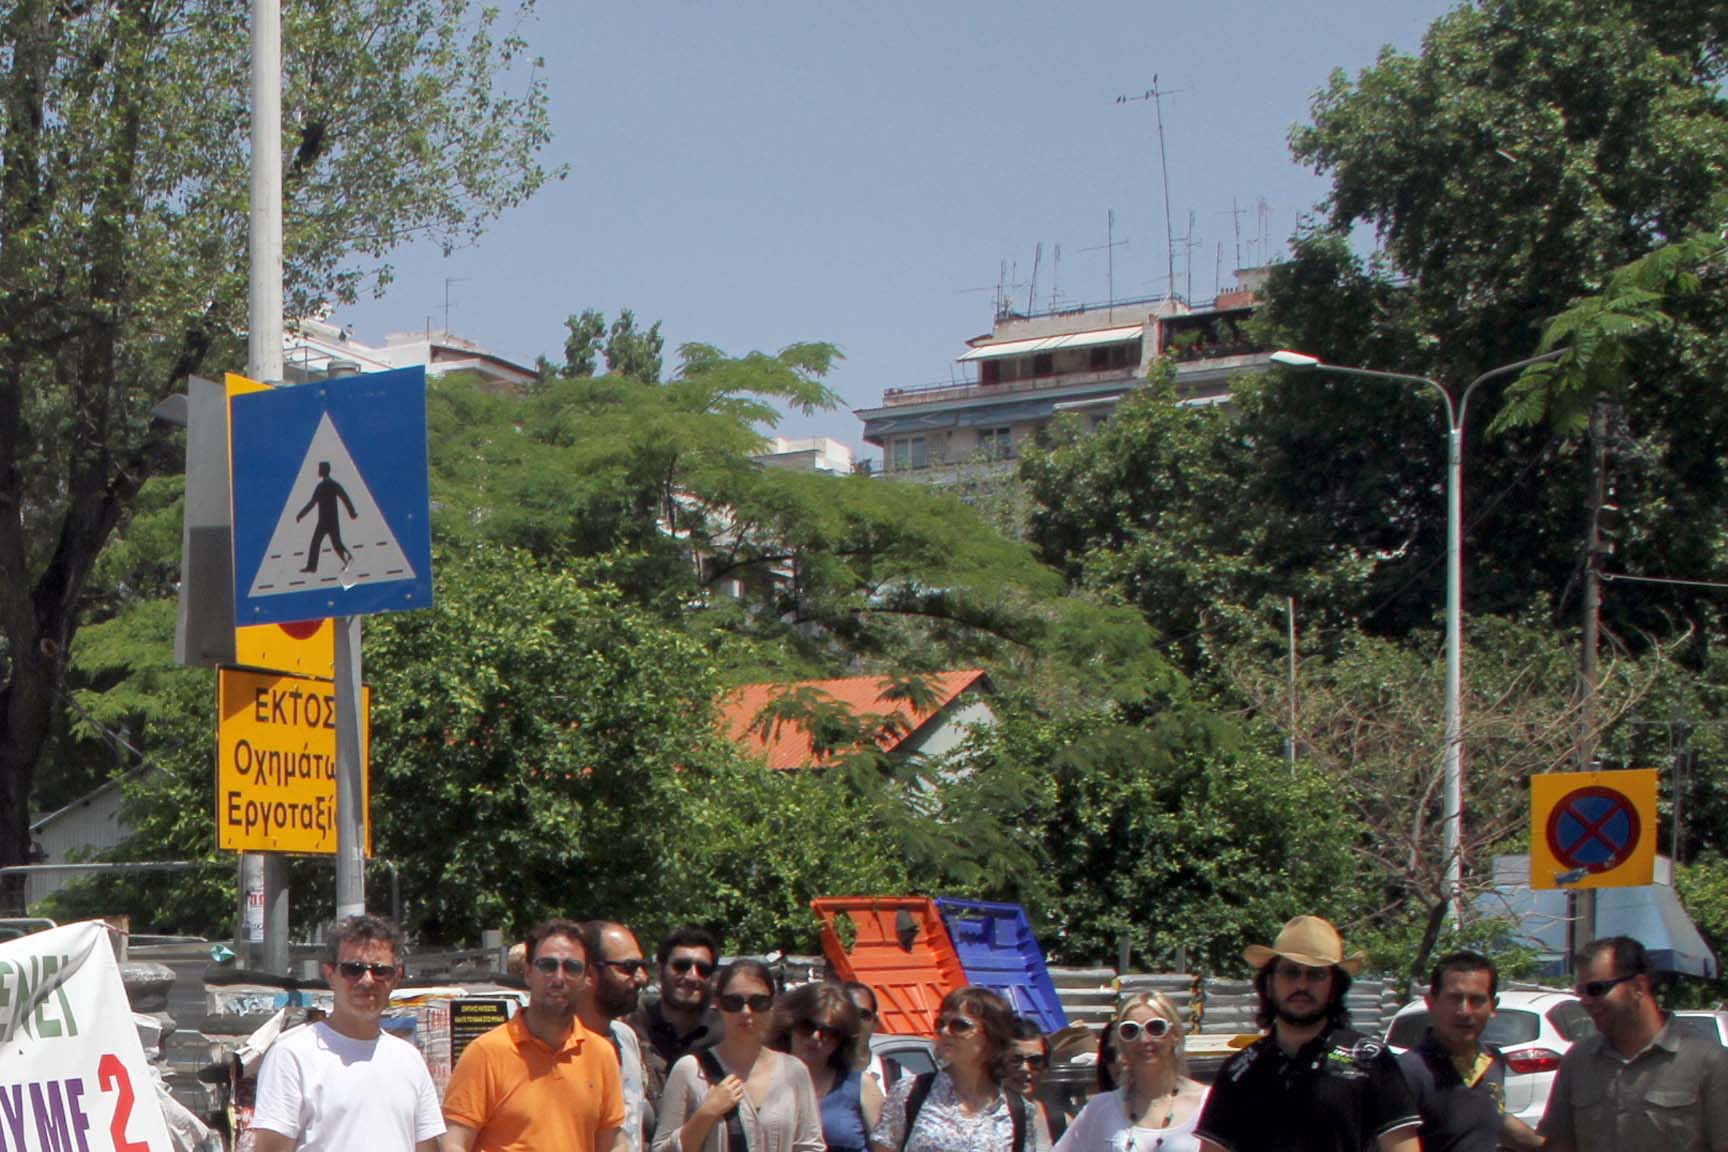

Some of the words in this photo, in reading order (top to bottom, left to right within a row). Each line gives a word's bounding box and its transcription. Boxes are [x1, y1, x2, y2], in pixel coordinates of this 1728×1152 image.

[255, 687, 337, 729] ΕΚΤΟΣ
[234, 738, 337, 787] Οχημάτω
[227, 791, 337, 839] Εργοταξί
